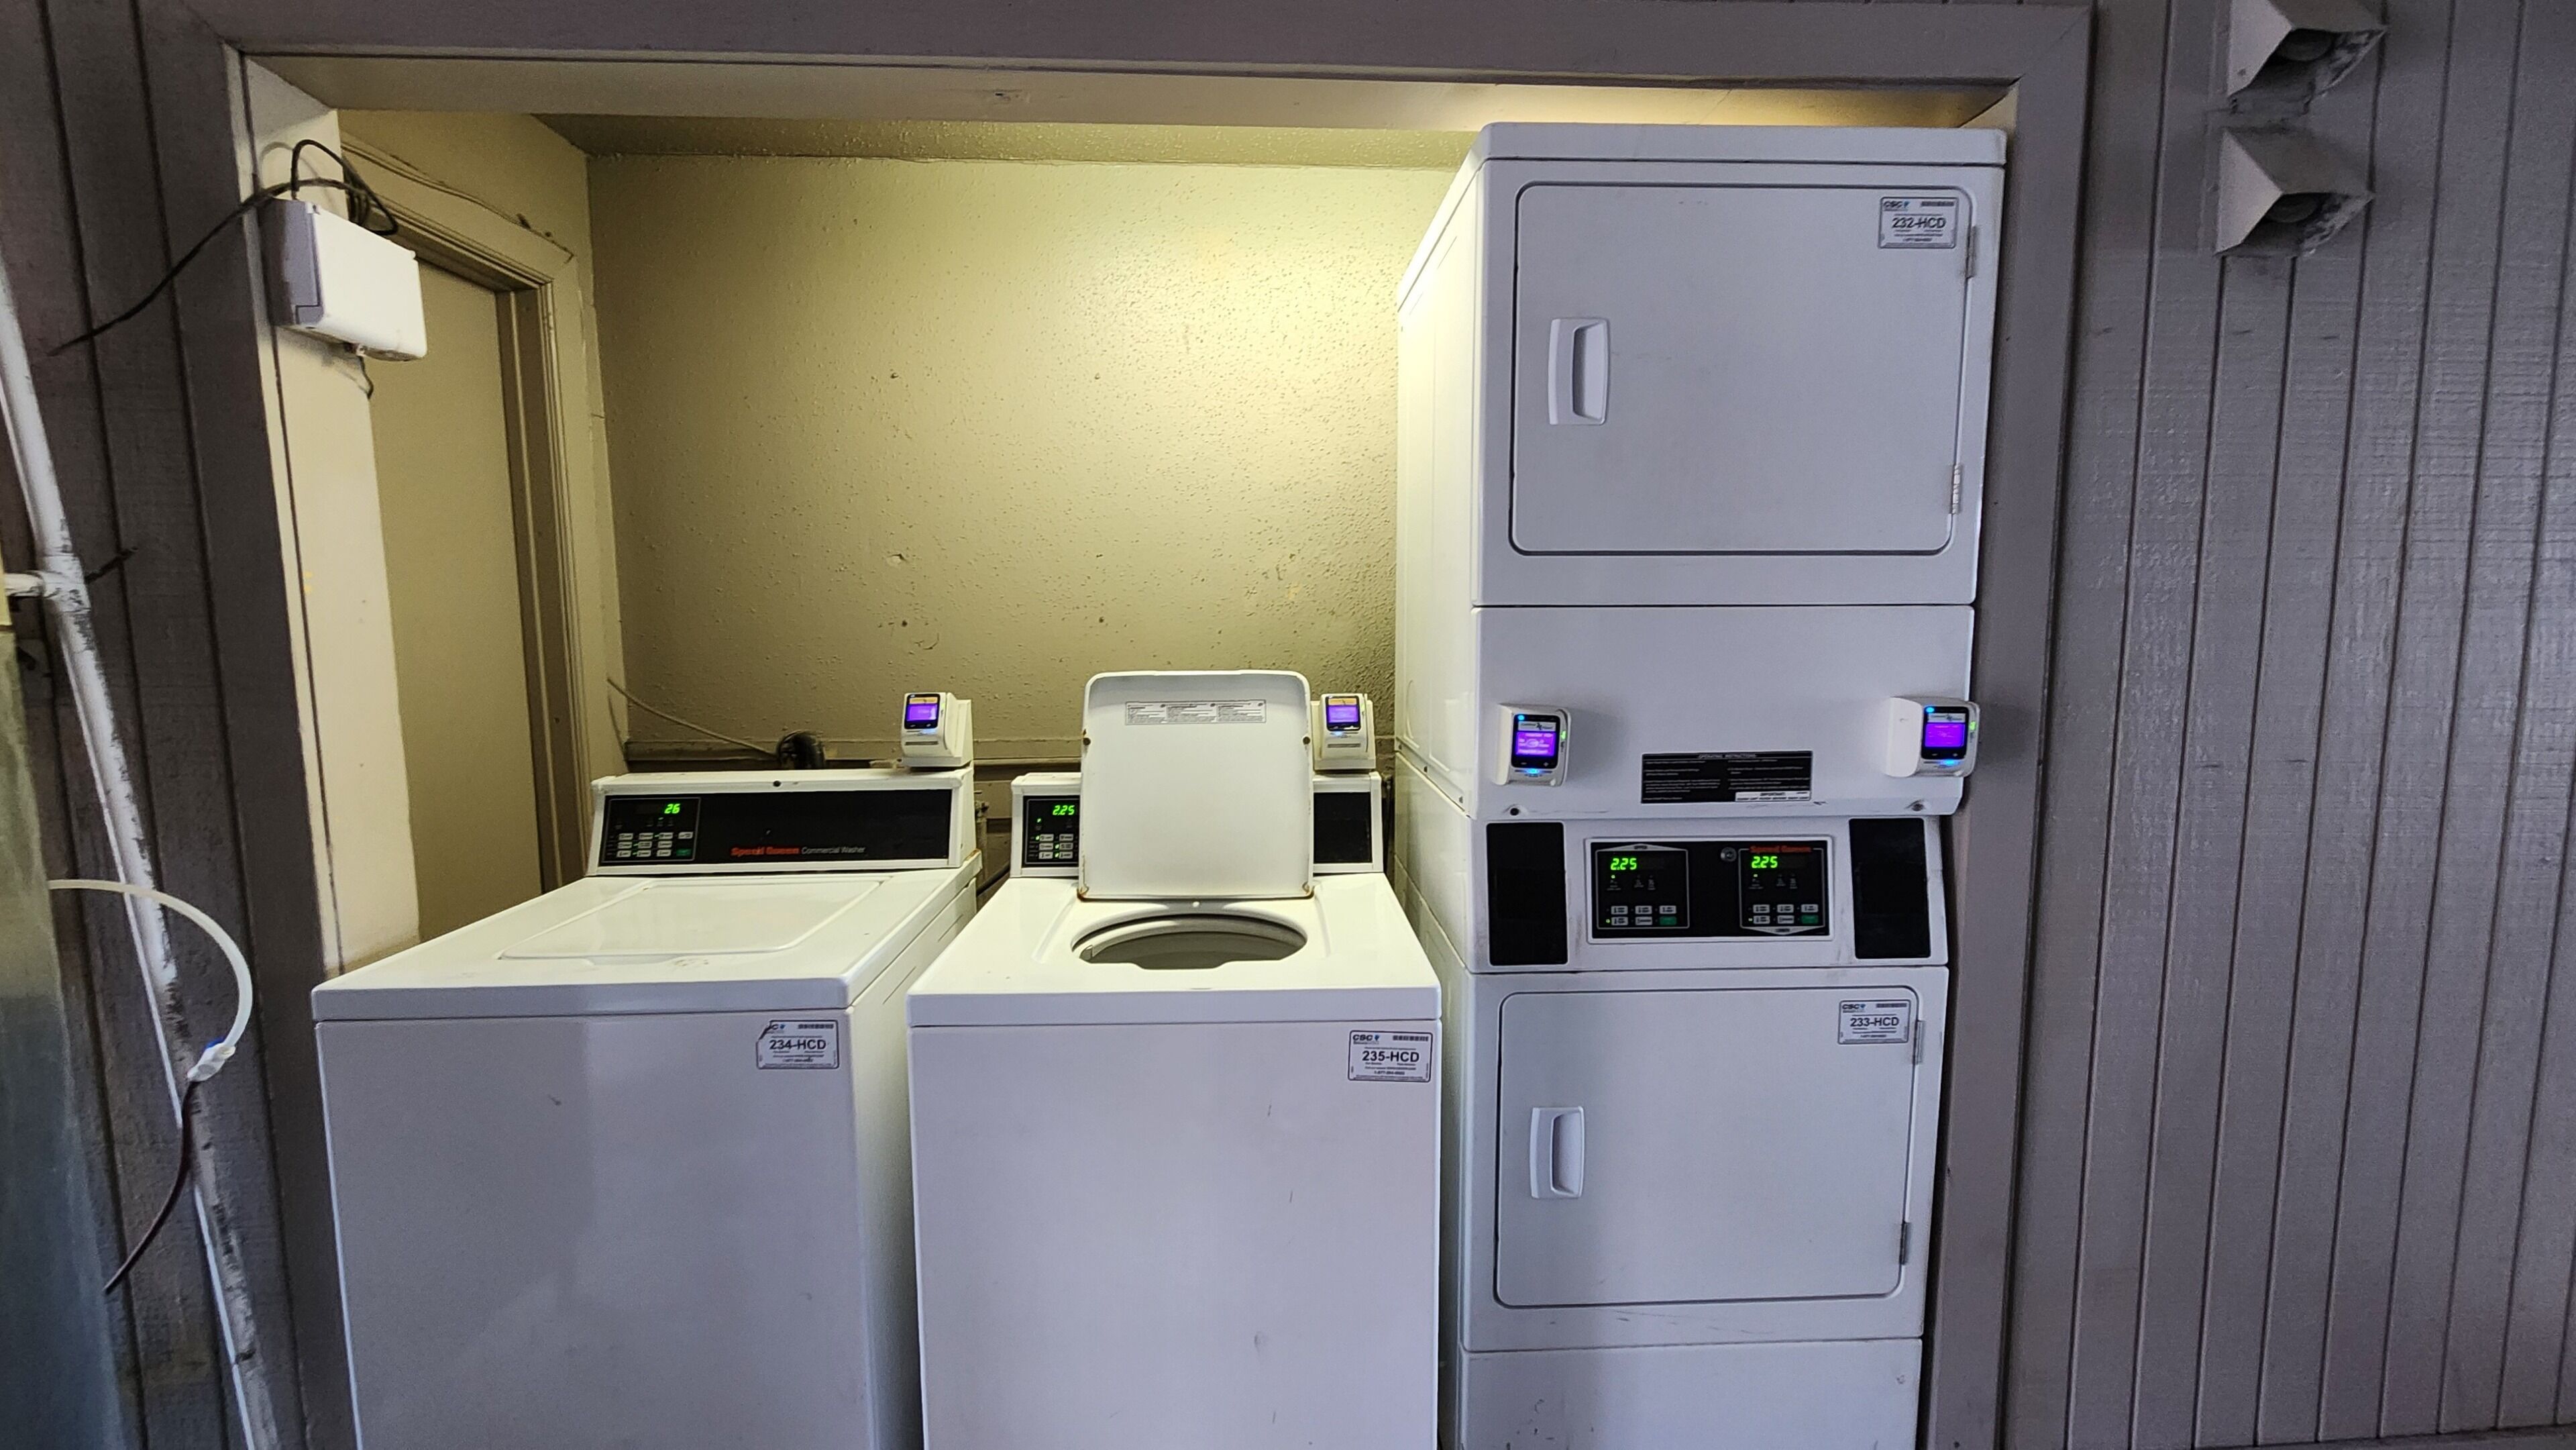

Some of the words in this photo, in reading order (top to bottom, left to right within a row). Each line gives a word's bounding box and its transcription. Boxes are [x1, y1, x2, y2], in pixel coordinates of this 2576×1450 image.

[1892, 217, 1946, 228] 232-HCD
[664, 803, 680, 813] 26
[1610, 858, 1637, 870] 2.25
[1752, 856, 1778, 868] 2.25
[1849, 1017, 1900, 1027] 233-HCD
[769, 1039, 826, 1049] 234-HCD
[1362, 1050, 1419, 1062] 235-HCD
